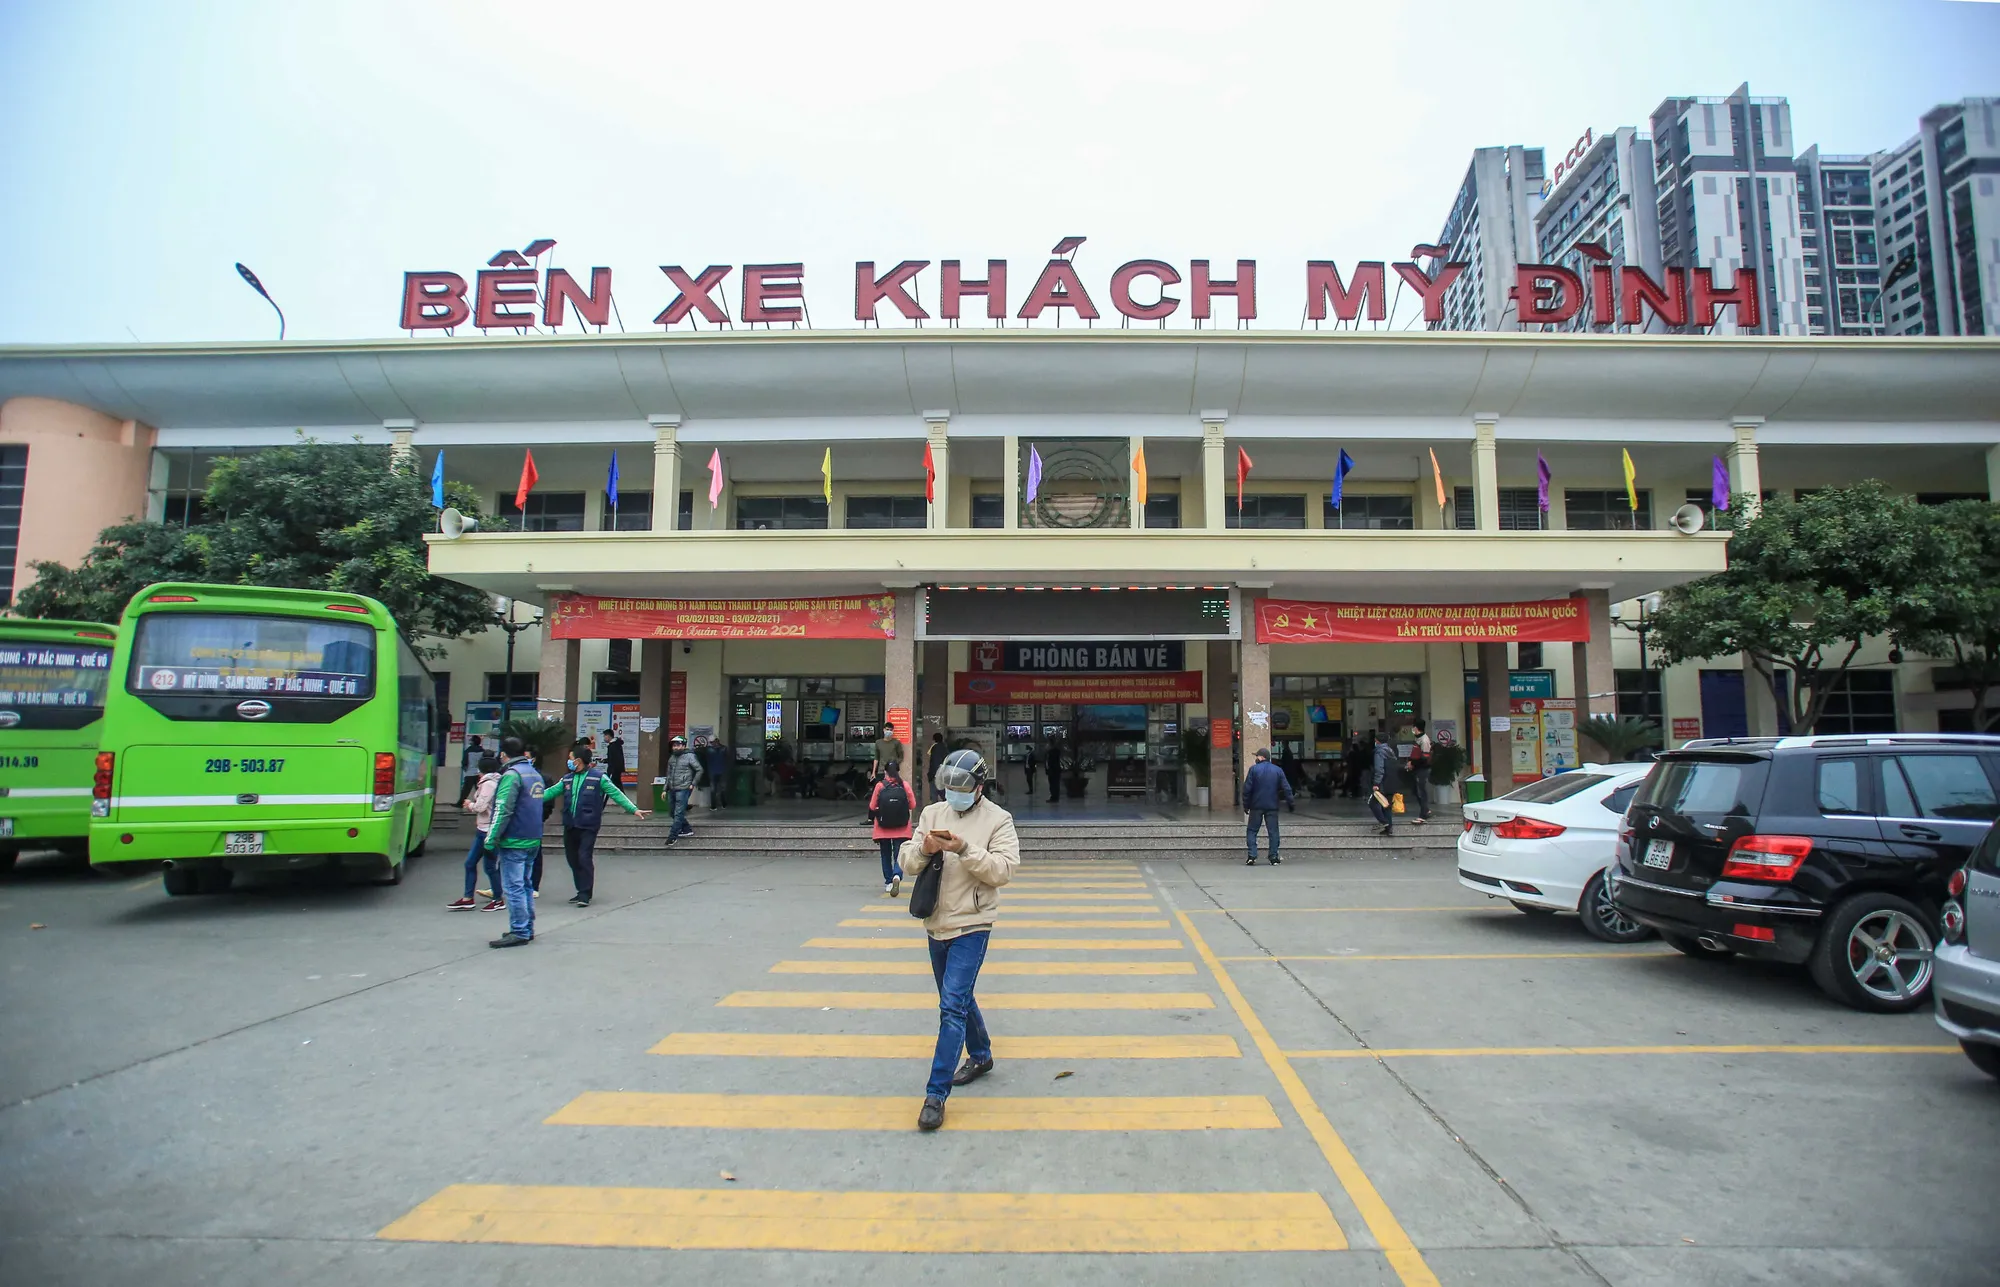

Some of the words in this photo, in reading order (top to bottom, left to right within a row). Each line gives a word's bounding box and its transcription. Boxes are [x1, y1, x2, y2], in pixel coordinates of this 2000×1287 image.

[1554, 127, 1592, 185] PCC1
[399, 239, 612, 329] BẾN
[653, 263, 804, 324] XE
[855, 236, 1257, 320] KHÁCH
[1306, 243, 1470, 322] MỸ
[1508, 243, 1760, 327] ĐÌNH
[680, 600, 687, 611] 91
[844, 599, 861, 610] NAM
[1337, 605, 1366, 621] NHIỆT
[1367, 605, 1388, 621] LIỆT
[1389, 606, 1415, 619] CHÀO
[1445, 607, 1462, 621] ĐẠI
[1464, 605, 1481, 621] HỘI
[1482, 607, 1499, 621] ĐẠI
[1524, 604, 1550, 618] TOÀN
[1552, 602, 1578, 619] QUỐC
[770, 625, 806, 636] 2021
[1397, 620, 1418, 637] LẦN
[1420, 622, 1442, 637] THỨ
[1444, 625, 1462, 636] XIII
[1464, 621, 1487, 636] CỦA
[1488, 621, 1518, 636] ĐẢNG
[28, 652, 37, 665] TP
[55, 653, 76, 666] NINH
[81, 652, 98, 668] QUẾ
[1019, 643, 1089, 668] PHÒNG
[1095, 643, 1137, 668] BÁN
[1144, 643, 1168, 668] VÉ
[154, 674, 175, 686] 212
[225, 675, 245, 690] SAM
[245, 676, 269, 690] SUNG
[274, 677, 286, 691] TP
[303, 679, 324, 693] NINH
[329, 676, 346, 695] QUẾ
[1509, 684, 1525, 692] BẾN
[205, 759, 231, 773] 29B
[240, 759, 285, 773] 503.87
[234, 833, 255, 844] 29B
[226, 843, 262, 854] 503.87
